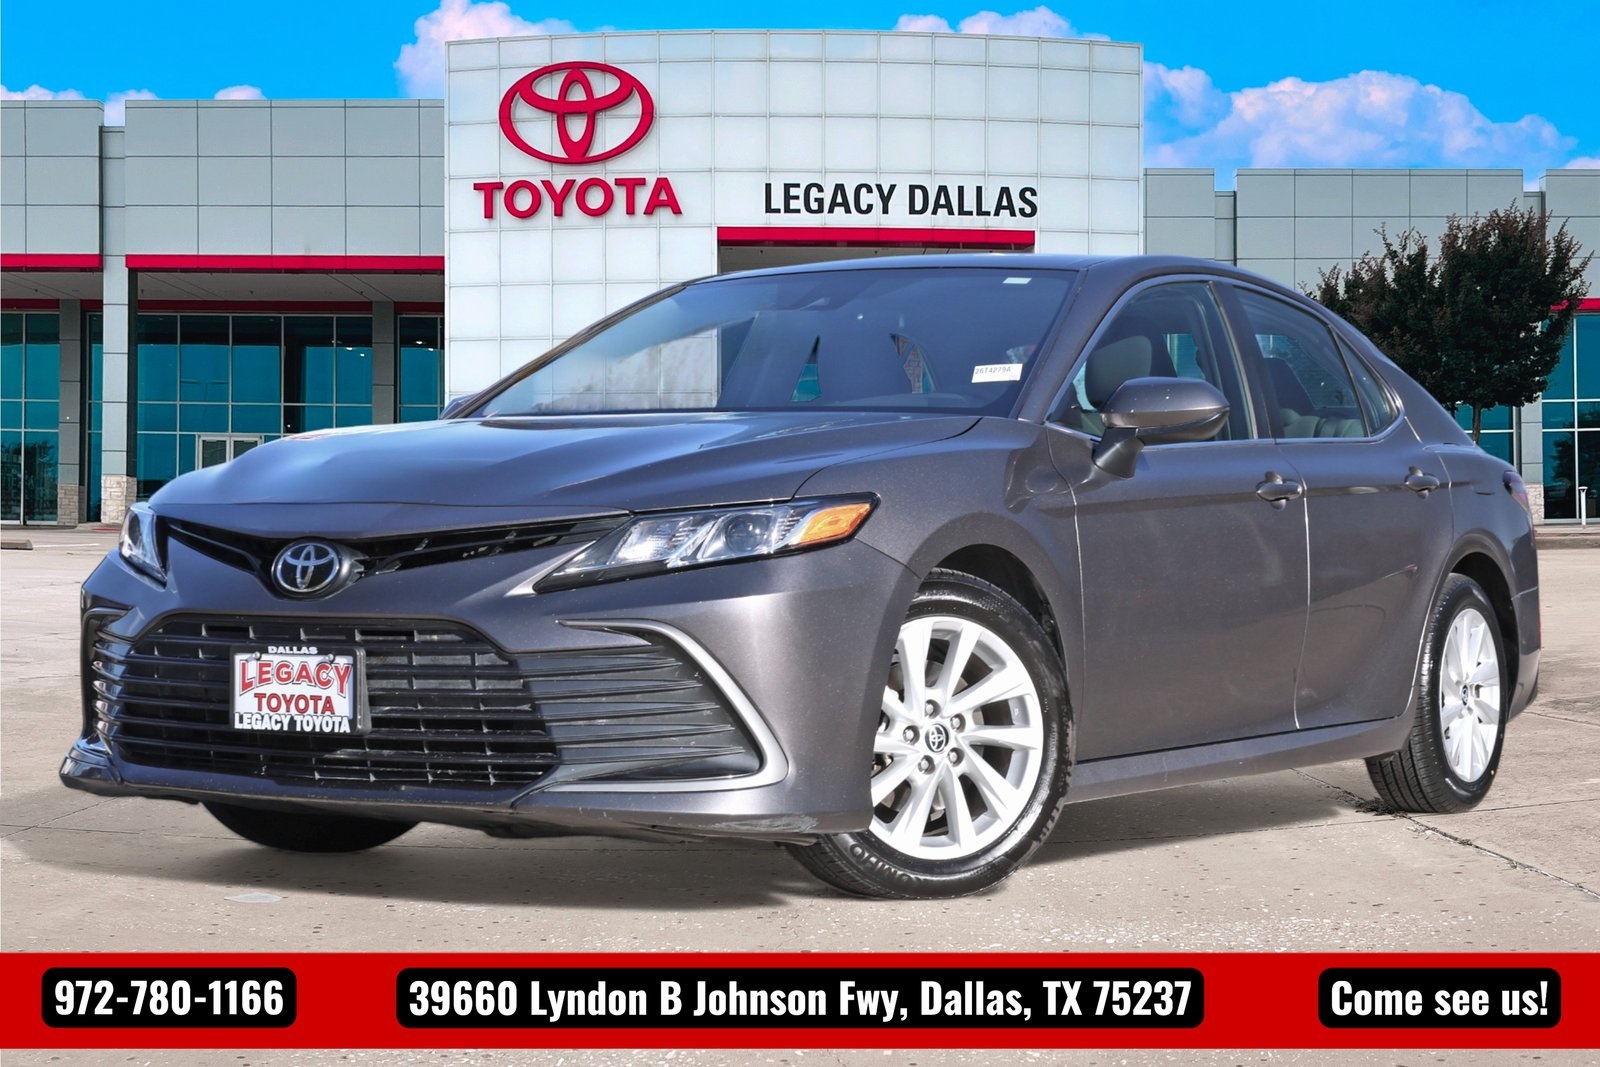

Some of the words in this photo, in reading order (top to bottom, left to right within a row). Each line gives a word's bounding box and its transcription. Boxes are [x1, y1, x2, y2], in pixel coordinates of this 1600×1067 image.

[473, 177, 682, 219] TOYOTA
[764, 183, 897, 215] LEGACY
[908, 184, 1038, 218] DALLAS
[268, 646, 318, 654] DALLAS
[240, 659, 352, 698] LEGACY
[254, 693, 335, 715] TOYOTA
[234, 712, 291, 730] LEGACY
[293, 715, 351, 733] TOYOTA
